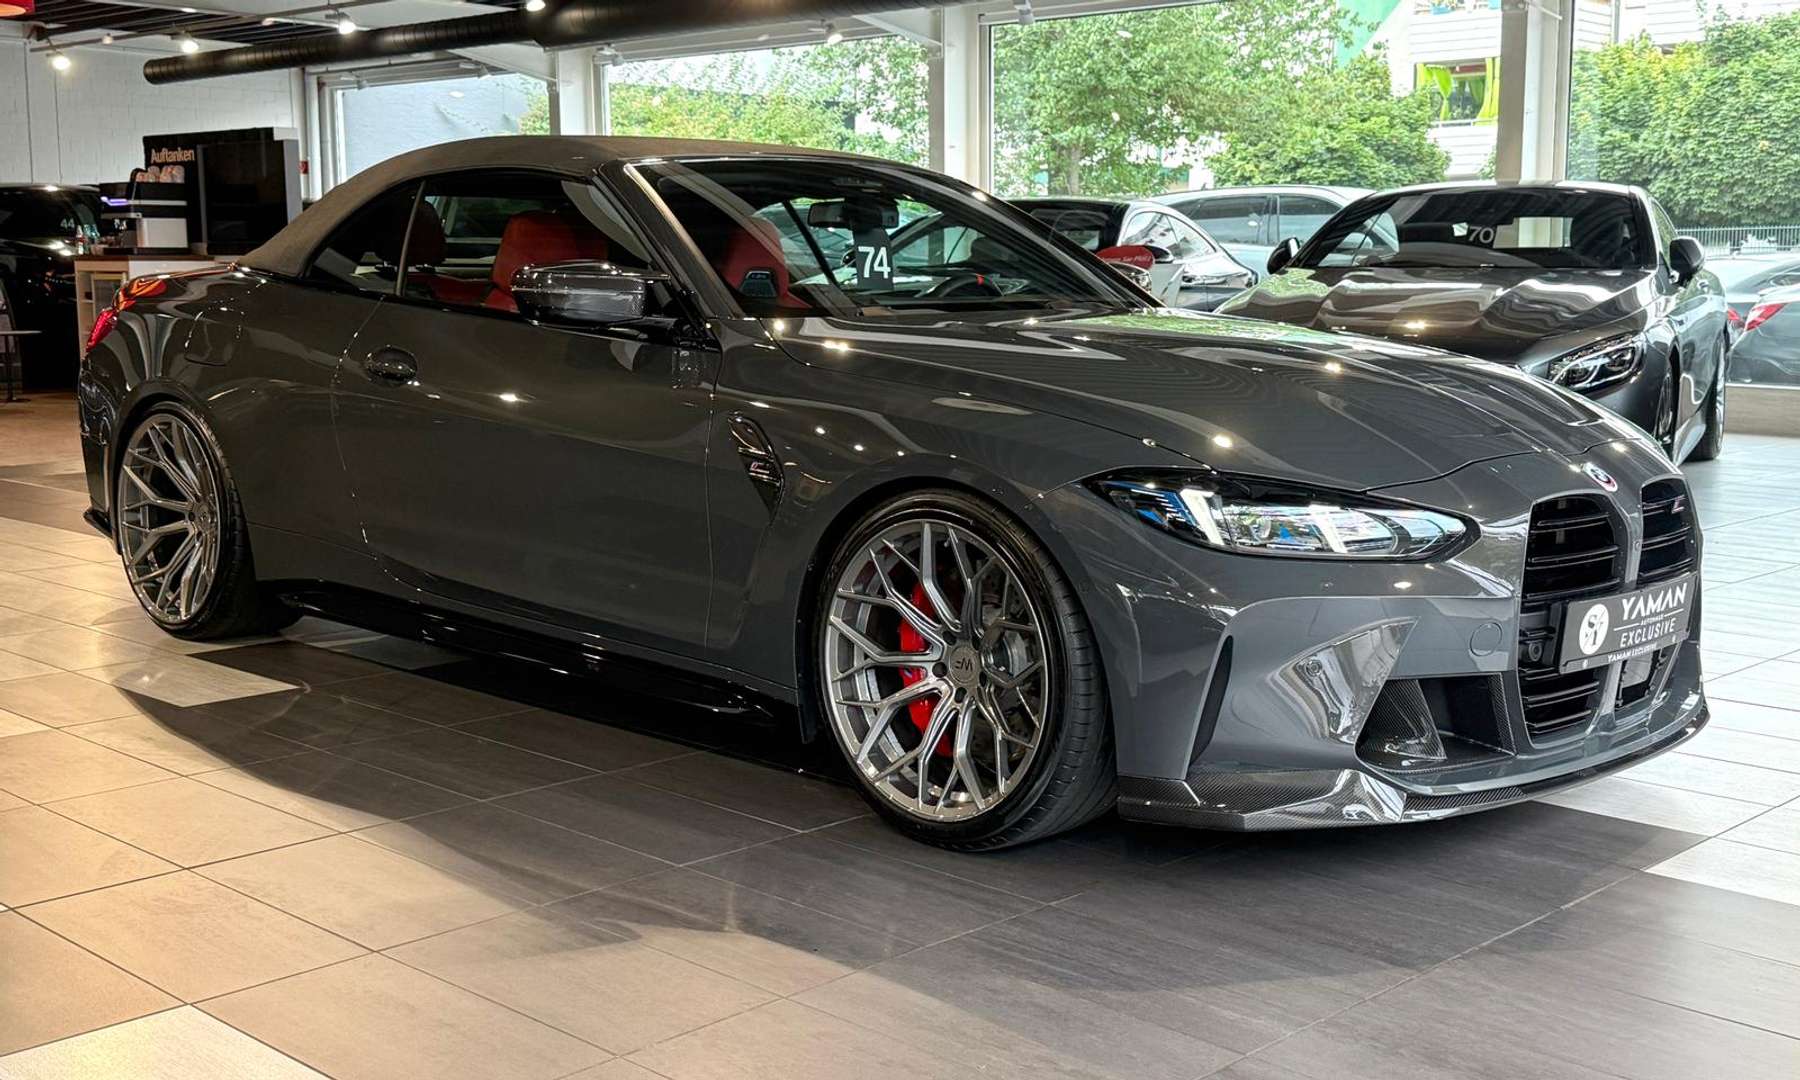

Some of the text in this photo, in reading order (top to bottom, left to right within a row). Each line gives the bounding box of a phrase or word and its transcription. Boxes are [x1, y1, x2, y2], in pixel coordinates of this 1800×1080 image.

[1469, 226, 1494, 243] 70
[858, 245, 891, 279] 74
[1622, 582, 1687, 620] YAMAN
[1620, 617, 1677, 648] EXCLUSIVE
[1607, 650, 1632, 663] YAMAN
